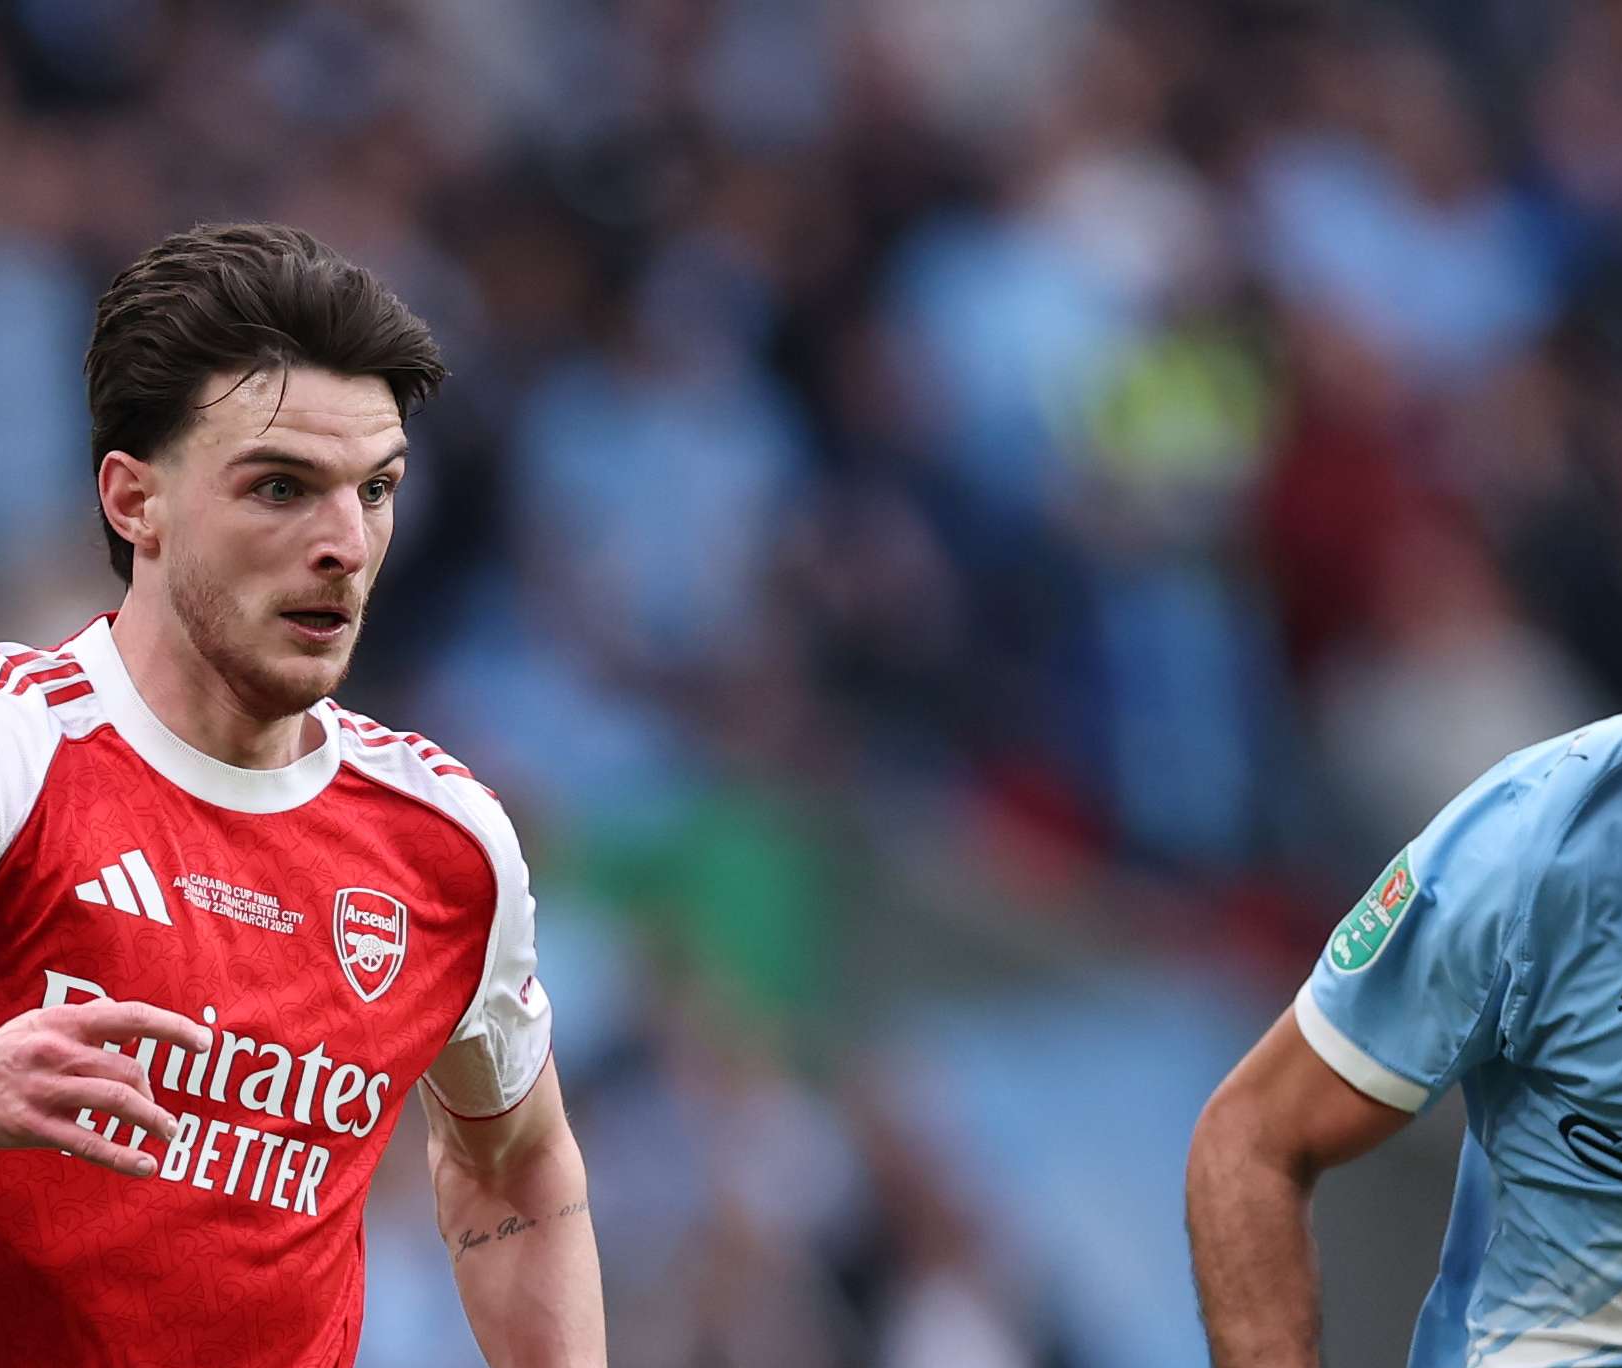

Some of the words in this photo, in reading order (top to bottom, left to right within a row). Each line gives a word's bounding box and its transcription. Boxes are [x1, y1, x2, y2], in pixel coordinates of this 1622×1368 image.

[211, 890, 220, 900] V
[281, 910, 304, 924] CITY
[233, 887, 253, 899] CUP
[254, 892, 280, 908] FINAL
[234, 911, 269, 929] MARCH
[269, 920, 294, 934] 2026
[344, 904, 396, 933] Arsenal
[42, 969, 391, 1138] irates
[159, 1111, 330, 1217] BETTER
